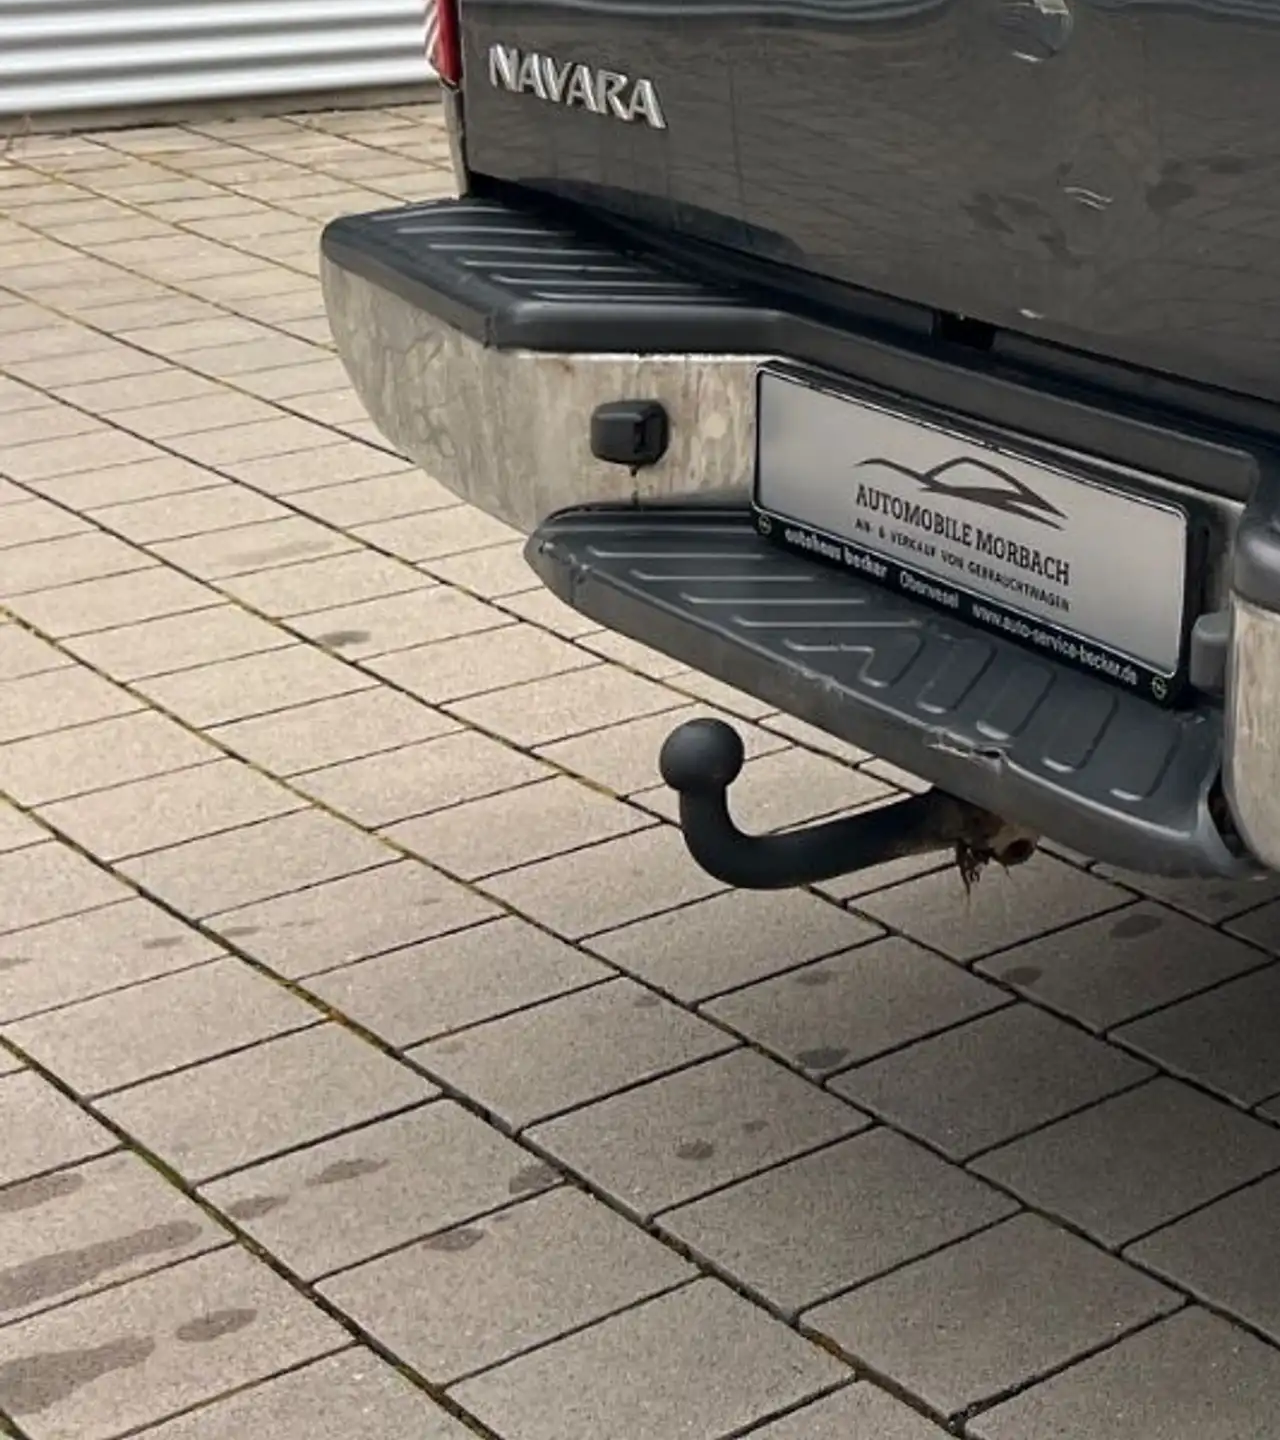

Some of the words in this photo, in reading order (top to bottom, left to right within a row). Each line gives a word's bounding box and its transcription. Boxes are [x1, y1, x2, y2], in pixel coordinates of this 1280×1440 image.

[488, 43, 667, 129] NAVARA
[855, 483, 973, 547] AUTOMOBILE
[975, 527, 1070, 587] MORBACH
[941, 549, 965, 572] VON
